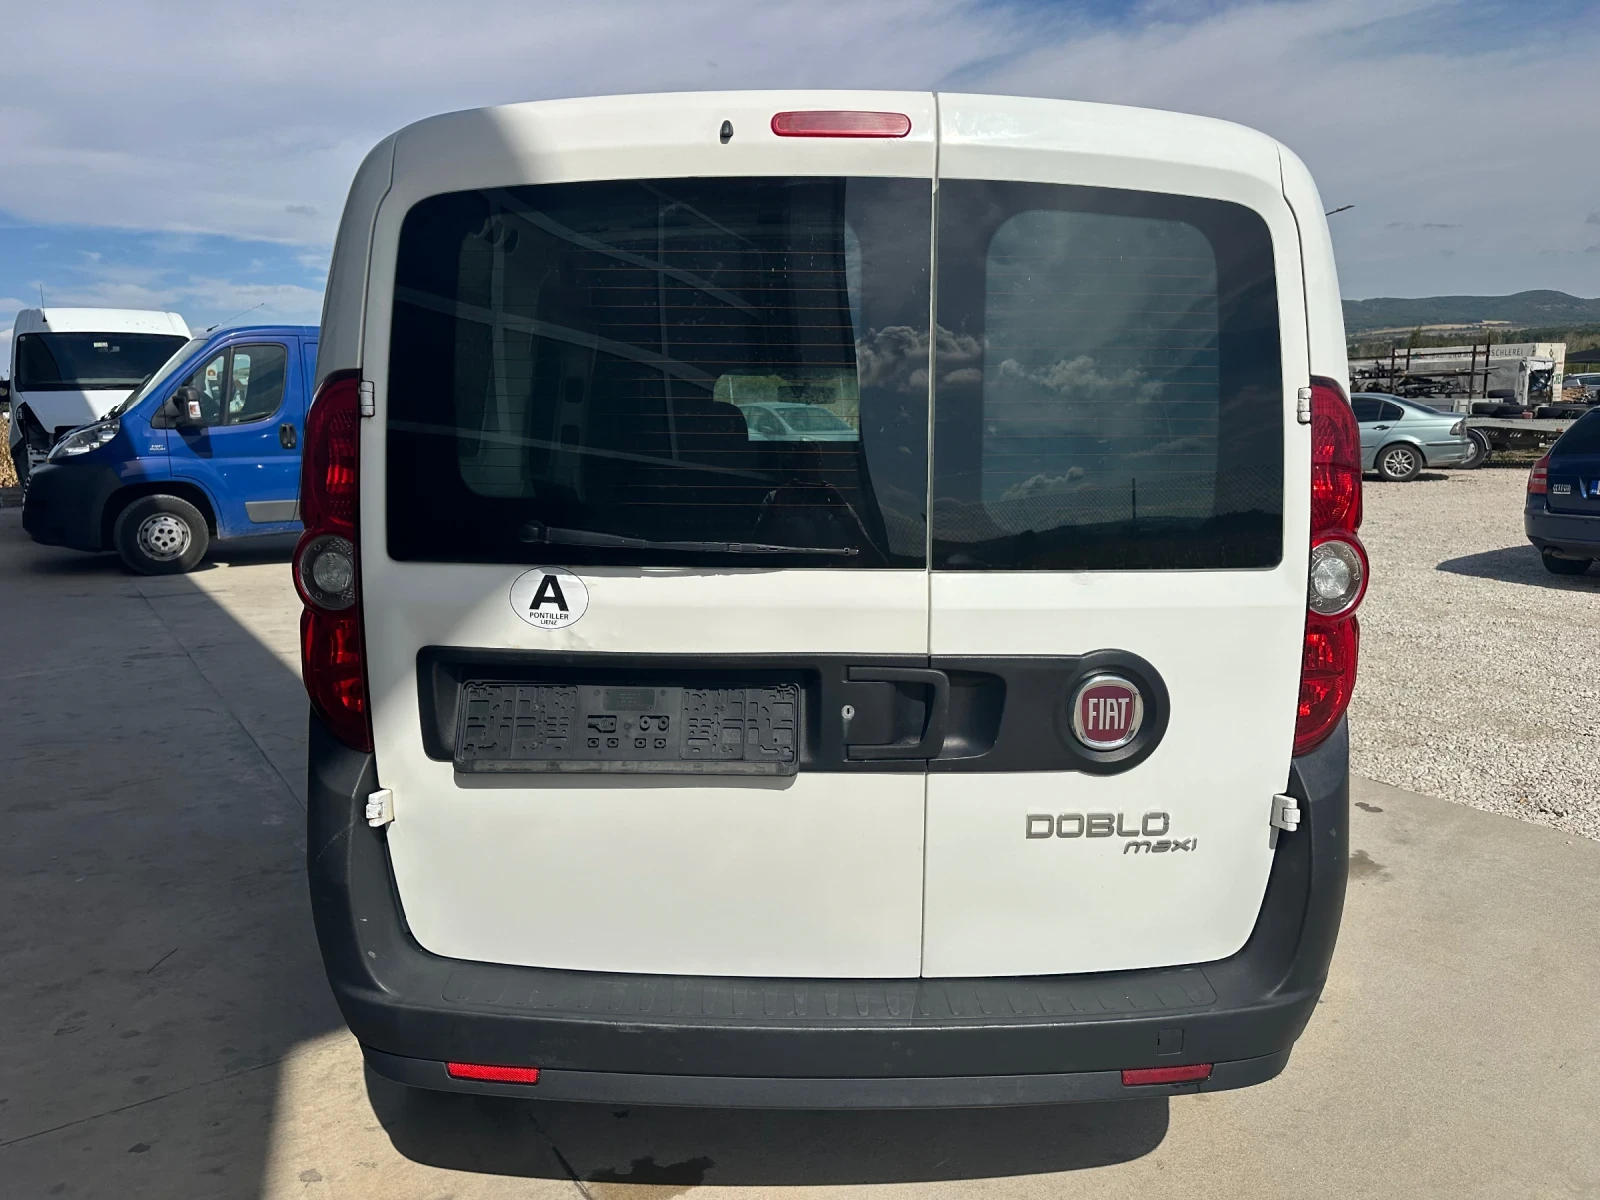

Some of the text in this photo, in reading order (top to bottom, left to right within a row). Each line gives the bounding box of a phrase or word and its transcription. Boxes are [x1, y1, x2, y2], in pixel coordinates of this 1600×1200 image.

[529, 574, 569, 612] A
[529, 612, 569, 620] PONTILLER
[1088, 698, 1130, 730] FIAT
